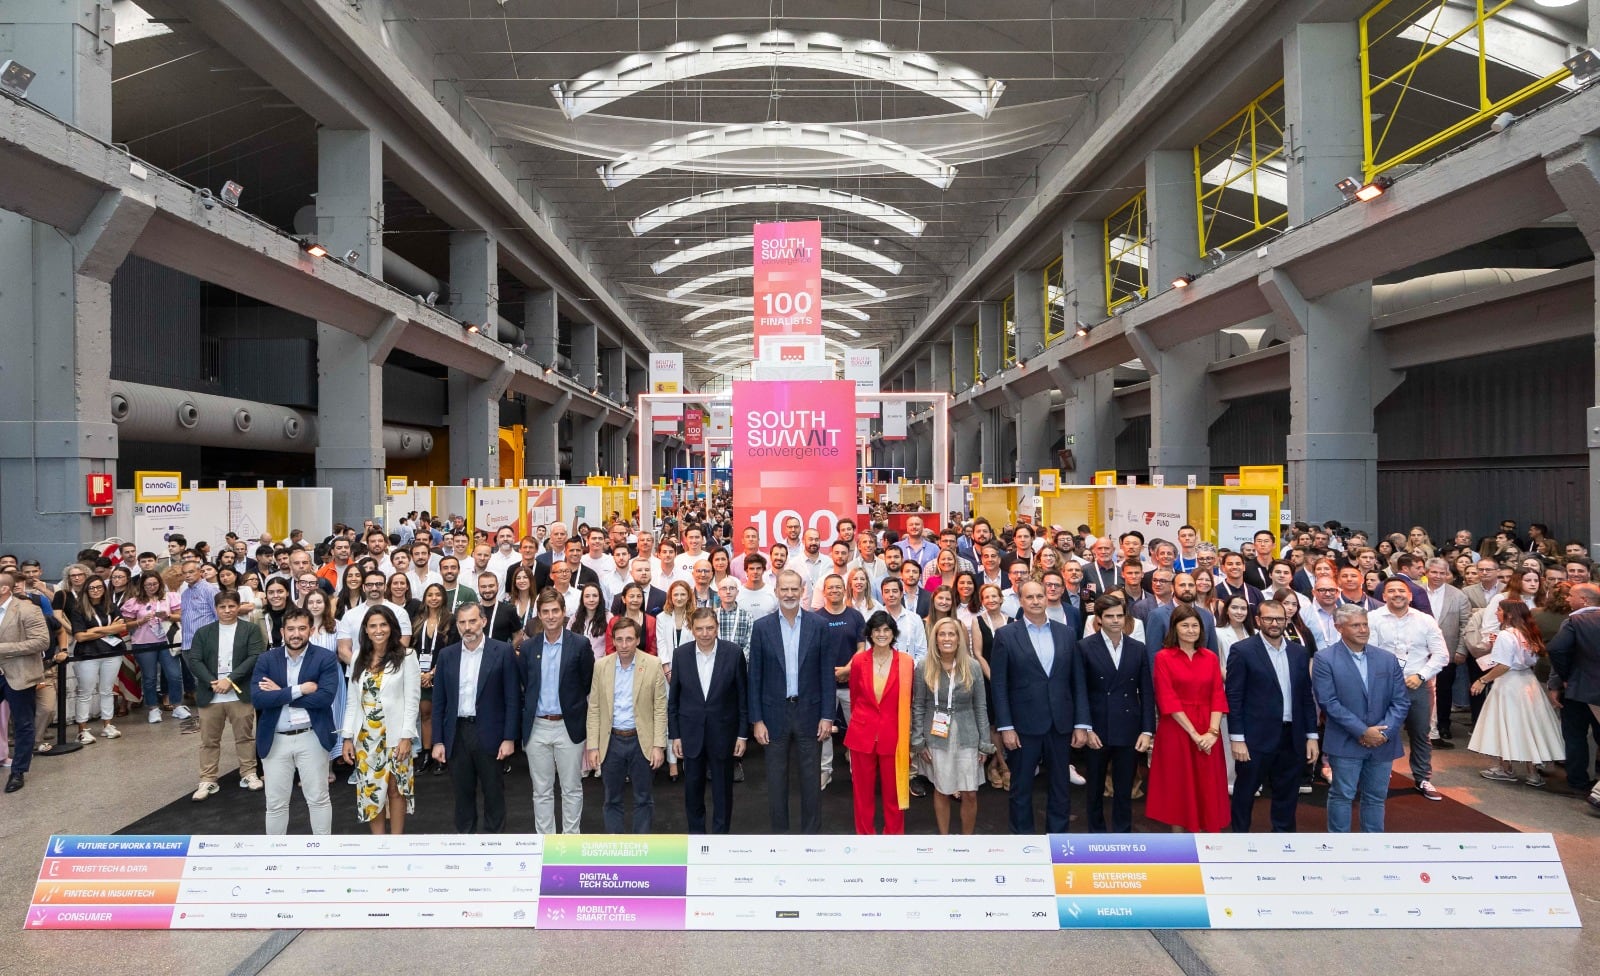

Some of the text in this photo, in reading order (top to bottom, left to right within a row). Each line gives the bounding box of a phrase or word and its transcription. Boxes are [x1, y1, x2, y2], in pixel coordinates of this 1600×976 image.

[761, 238, 805, 250] SOUTH
[762, 257, 812, 265] convergence
[762, 292, 812, 315] 100
[760, 316, 813, 326] FINALISTS
[747, 411, 826, 429] SOUTH
[748, 447, 839, 460] convergence
[750, 509, 839, 548] 100
[1088, 844, 1147, 852] INDUSTRY 5.0
[579, 873, 619, 881] DIGITAL &
[1092, 872, 1148, 881] ENTERPRISE
[579, 880, 650, 888] TECH SOLUTIONS
[1093, 881, 1142, 889] SOLUTIONS
[576, 906, 626, 914] MOBILITY &
[1097, 908, 1133, 917] HEALTH
[57, 913, 113, 922] CONSUMER
[576, 913, 637, 923] SMART CITIES
